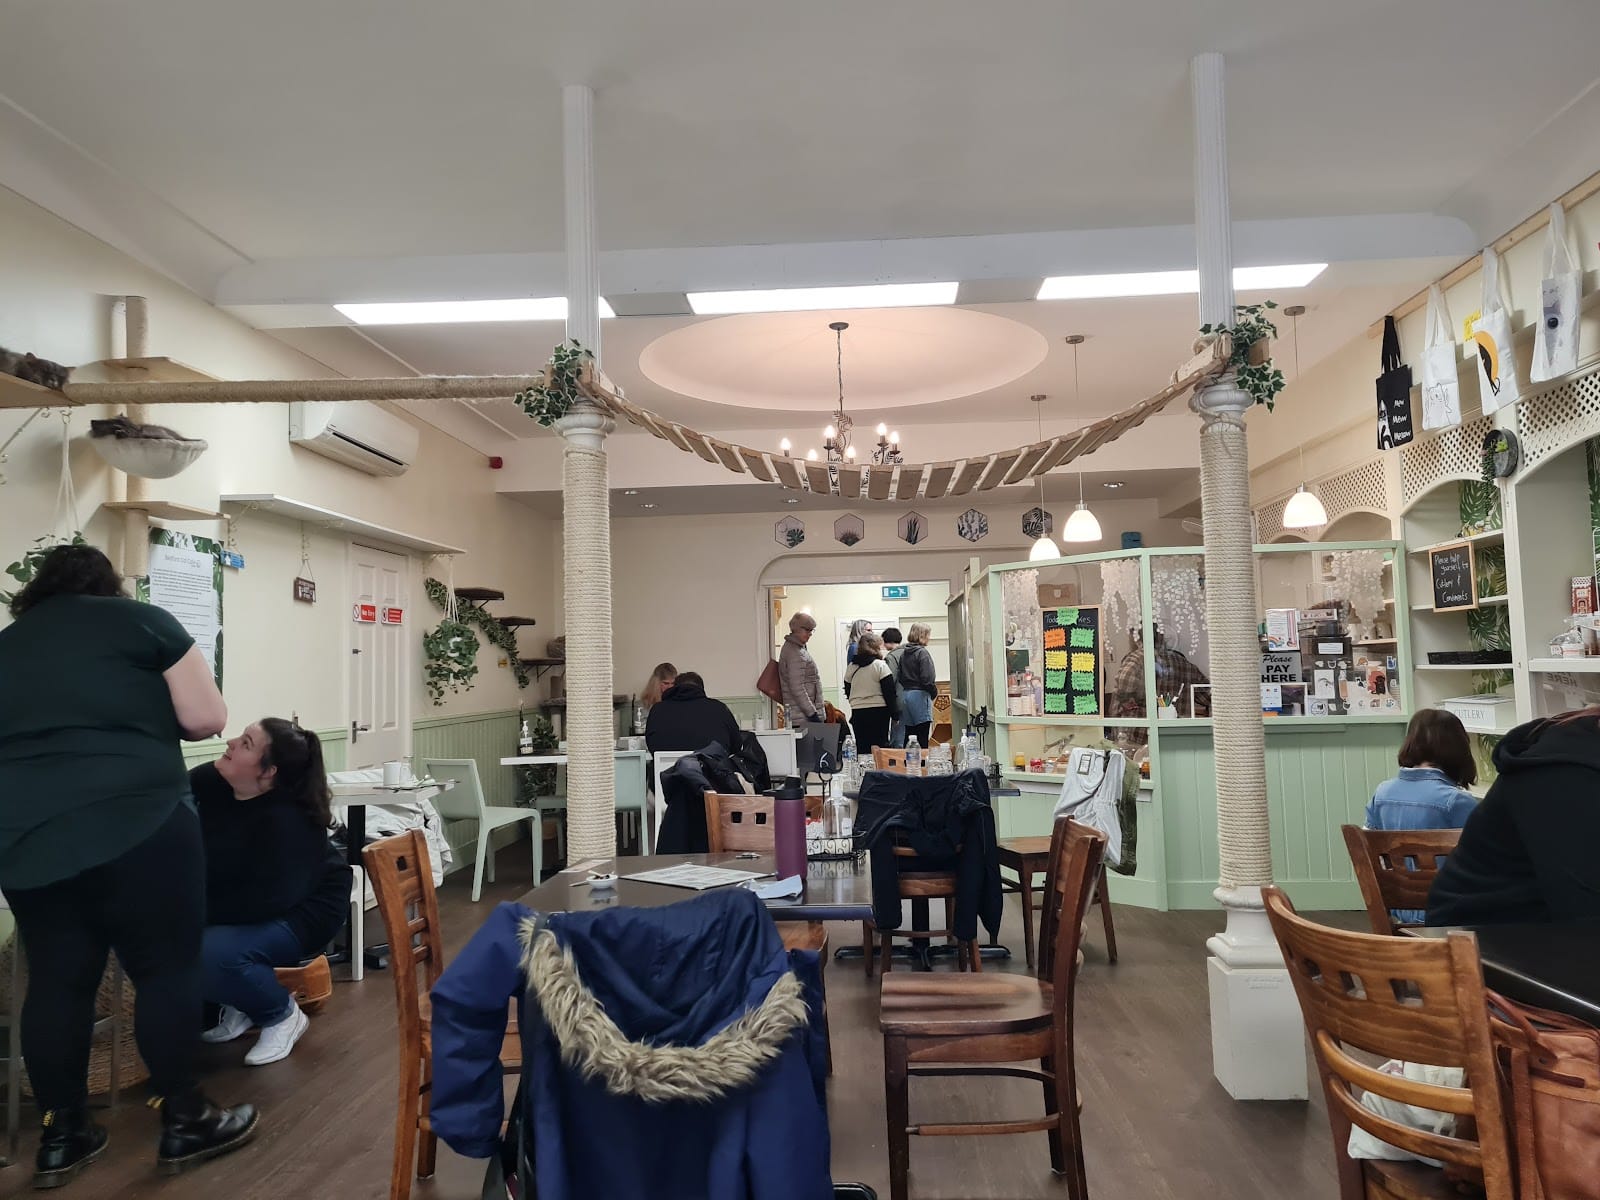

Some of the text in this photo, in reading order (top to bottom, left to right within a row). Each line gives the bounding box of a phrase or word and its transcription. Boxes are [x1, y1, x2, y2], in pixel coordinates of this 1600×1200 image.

[1262, 654, 1292, 663] Please
[1266, 665, 1290, 673] PAY
[1261, 674, 1297, 683] HERE
[820, 751, 829, 769] 6
